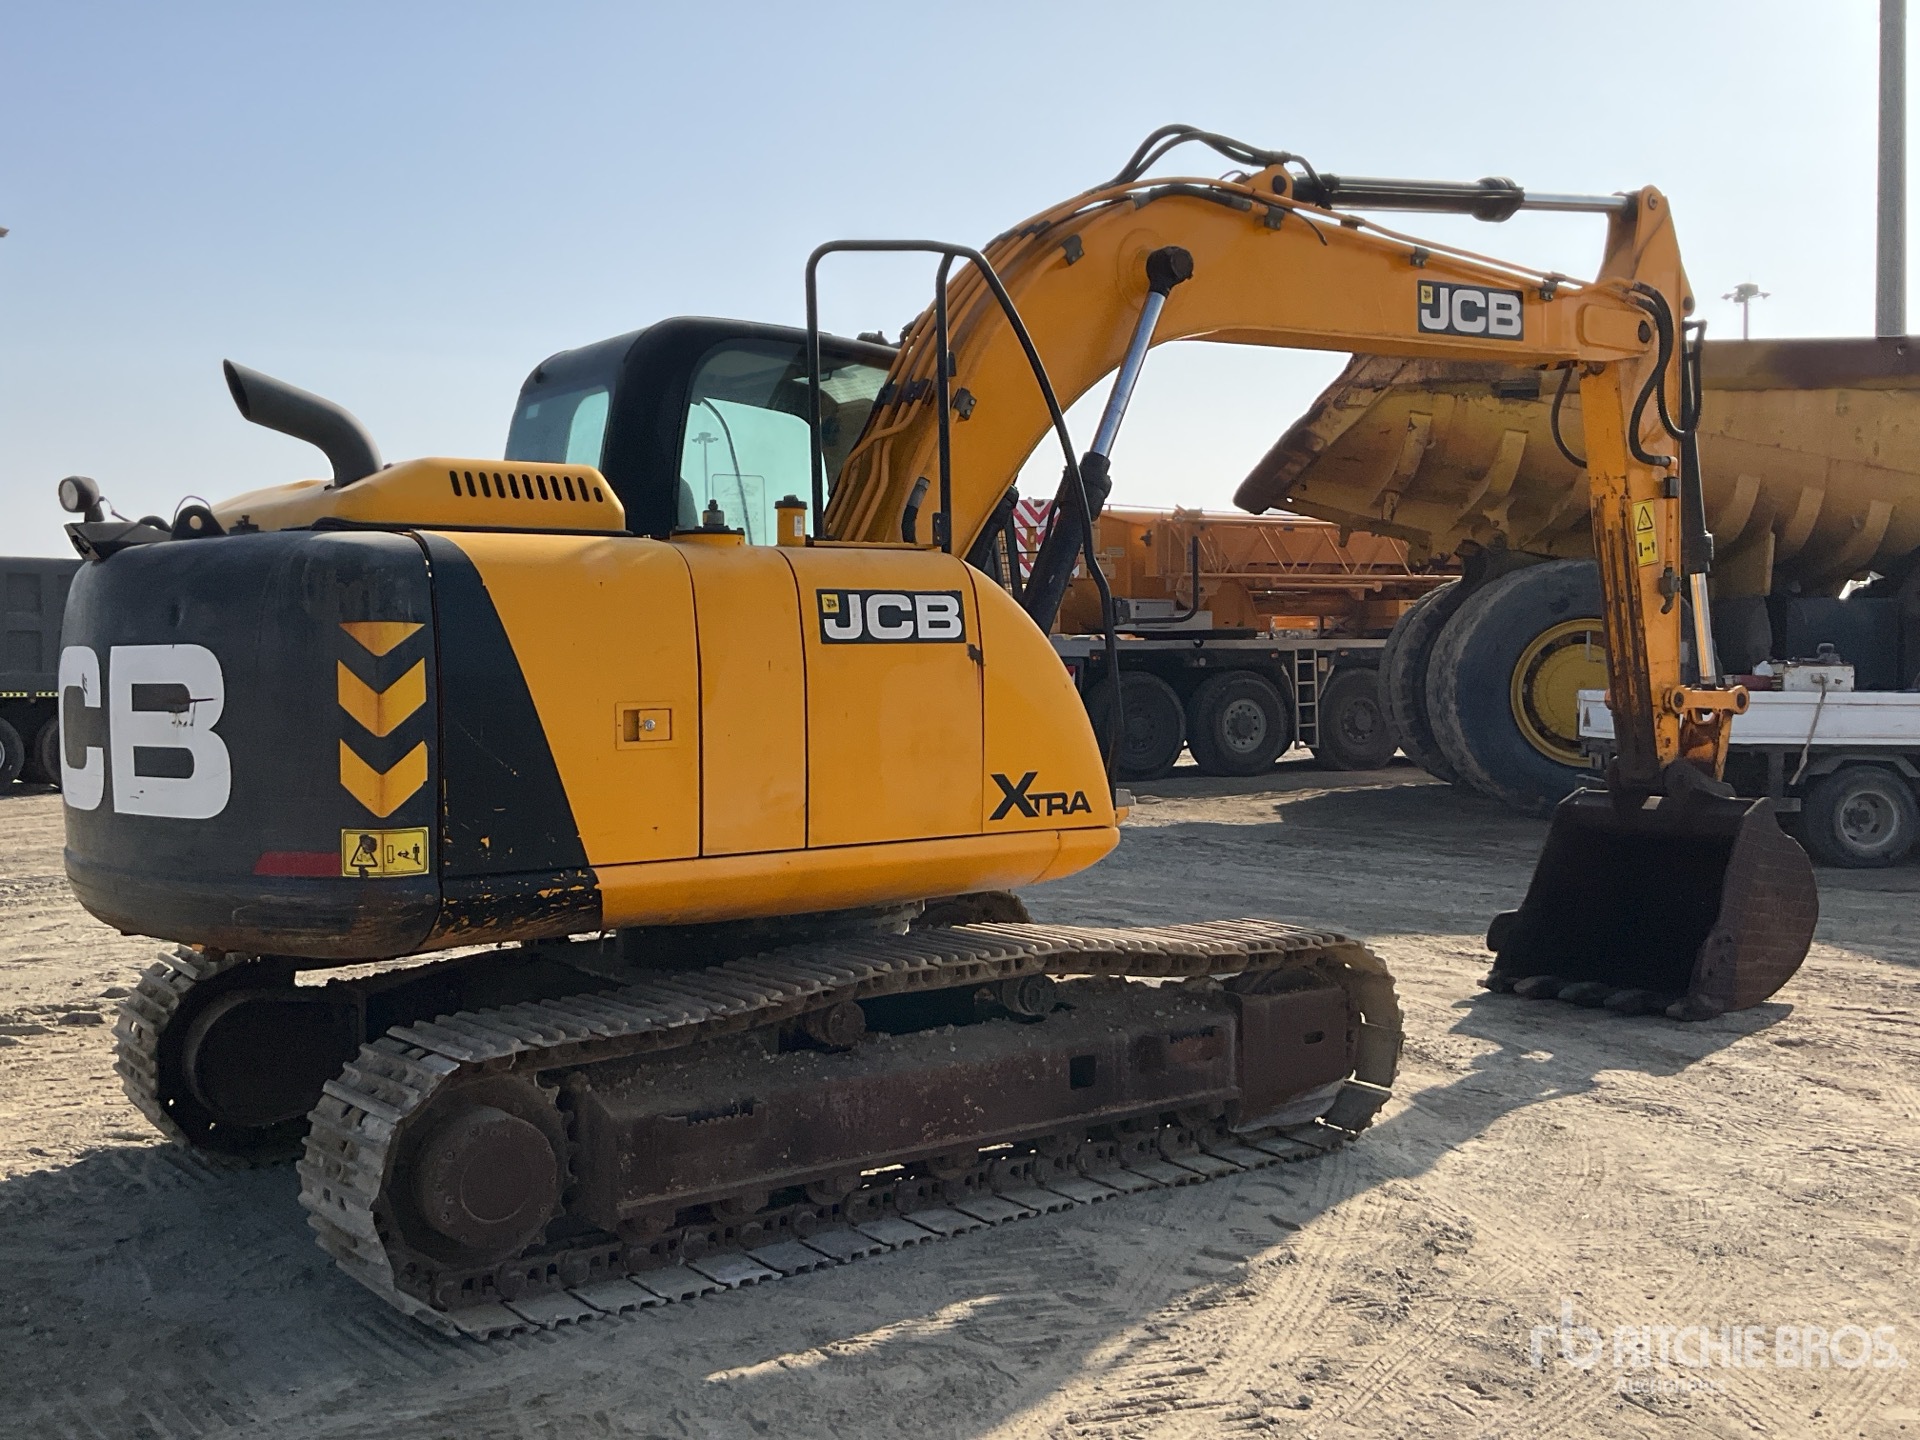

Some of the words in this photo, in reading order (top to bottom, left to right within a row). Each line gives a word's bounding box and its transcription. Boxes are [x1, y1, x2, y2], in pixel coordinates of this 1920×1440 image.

[1421, 287, 1522, 336] JCB
[824, 593, 963, 639] JCB
[58, 643, 232, 820] CB
[988, 771, 1093, 821] XTRA
